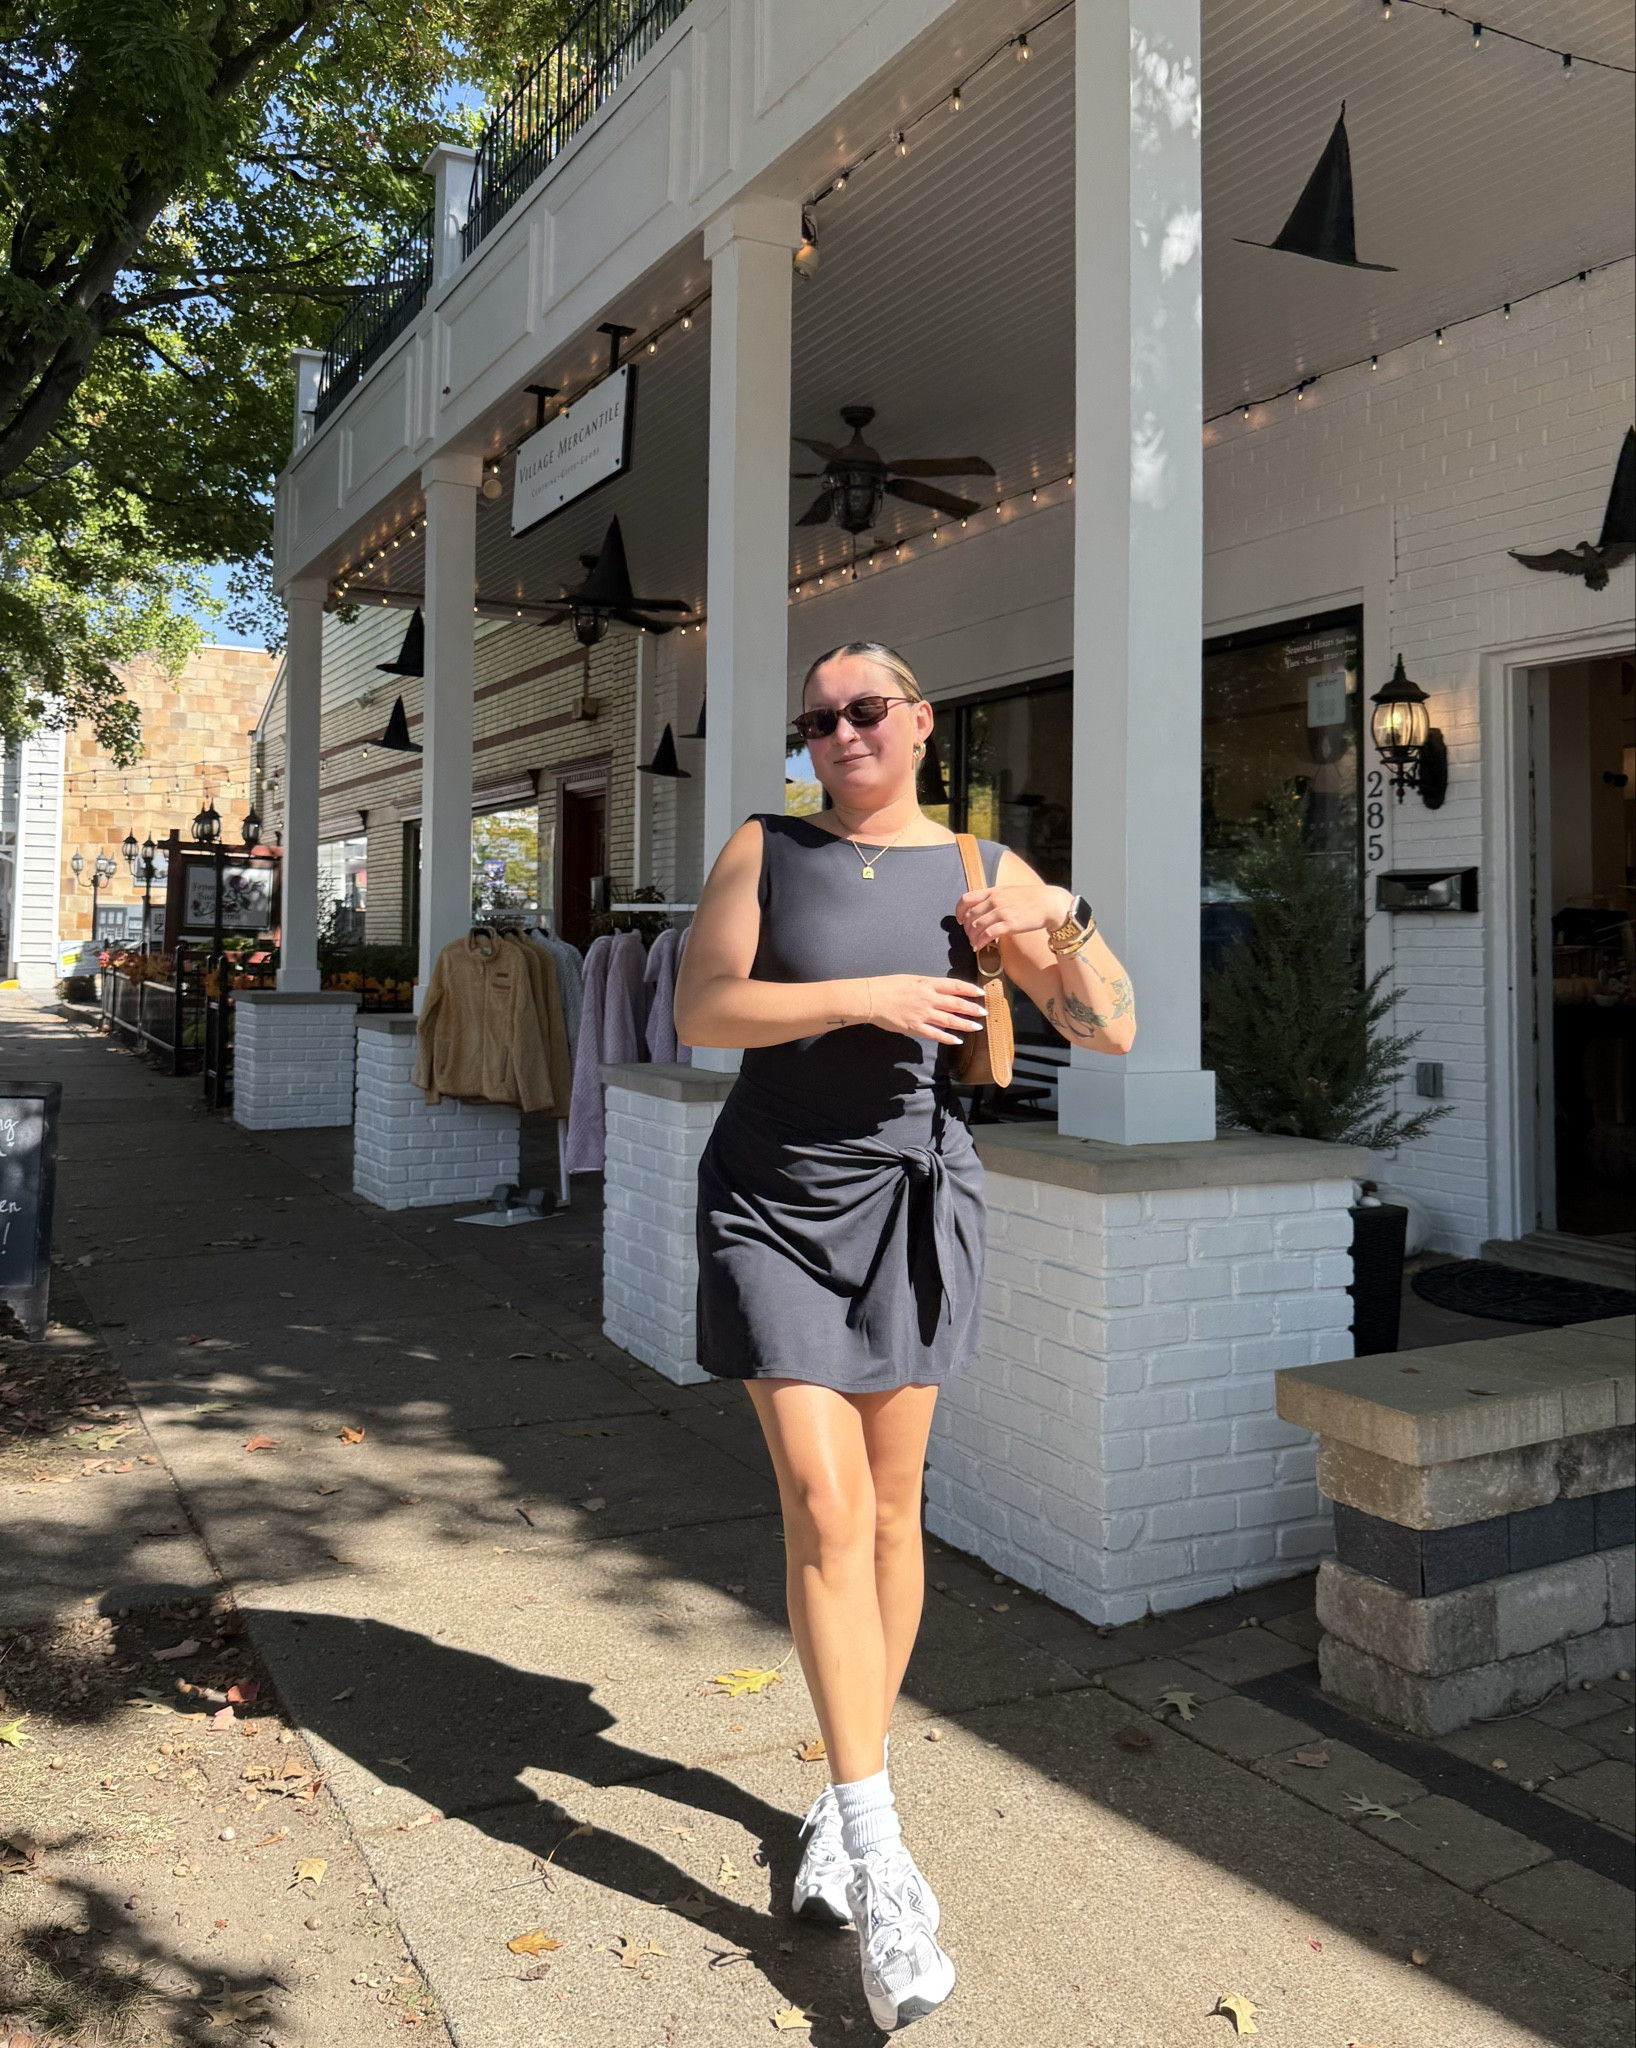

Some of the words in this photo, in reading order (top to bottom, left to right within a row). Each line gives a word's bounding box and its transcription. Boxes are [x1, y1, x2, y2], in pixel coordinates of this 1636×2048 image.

[519, 450, 555, 484] VILLAGE
[557, 402, 620, 459] MERCANTILE
[1313, 639, 1335, 650] Hours
[1367, 771, 1386, 861] 285
